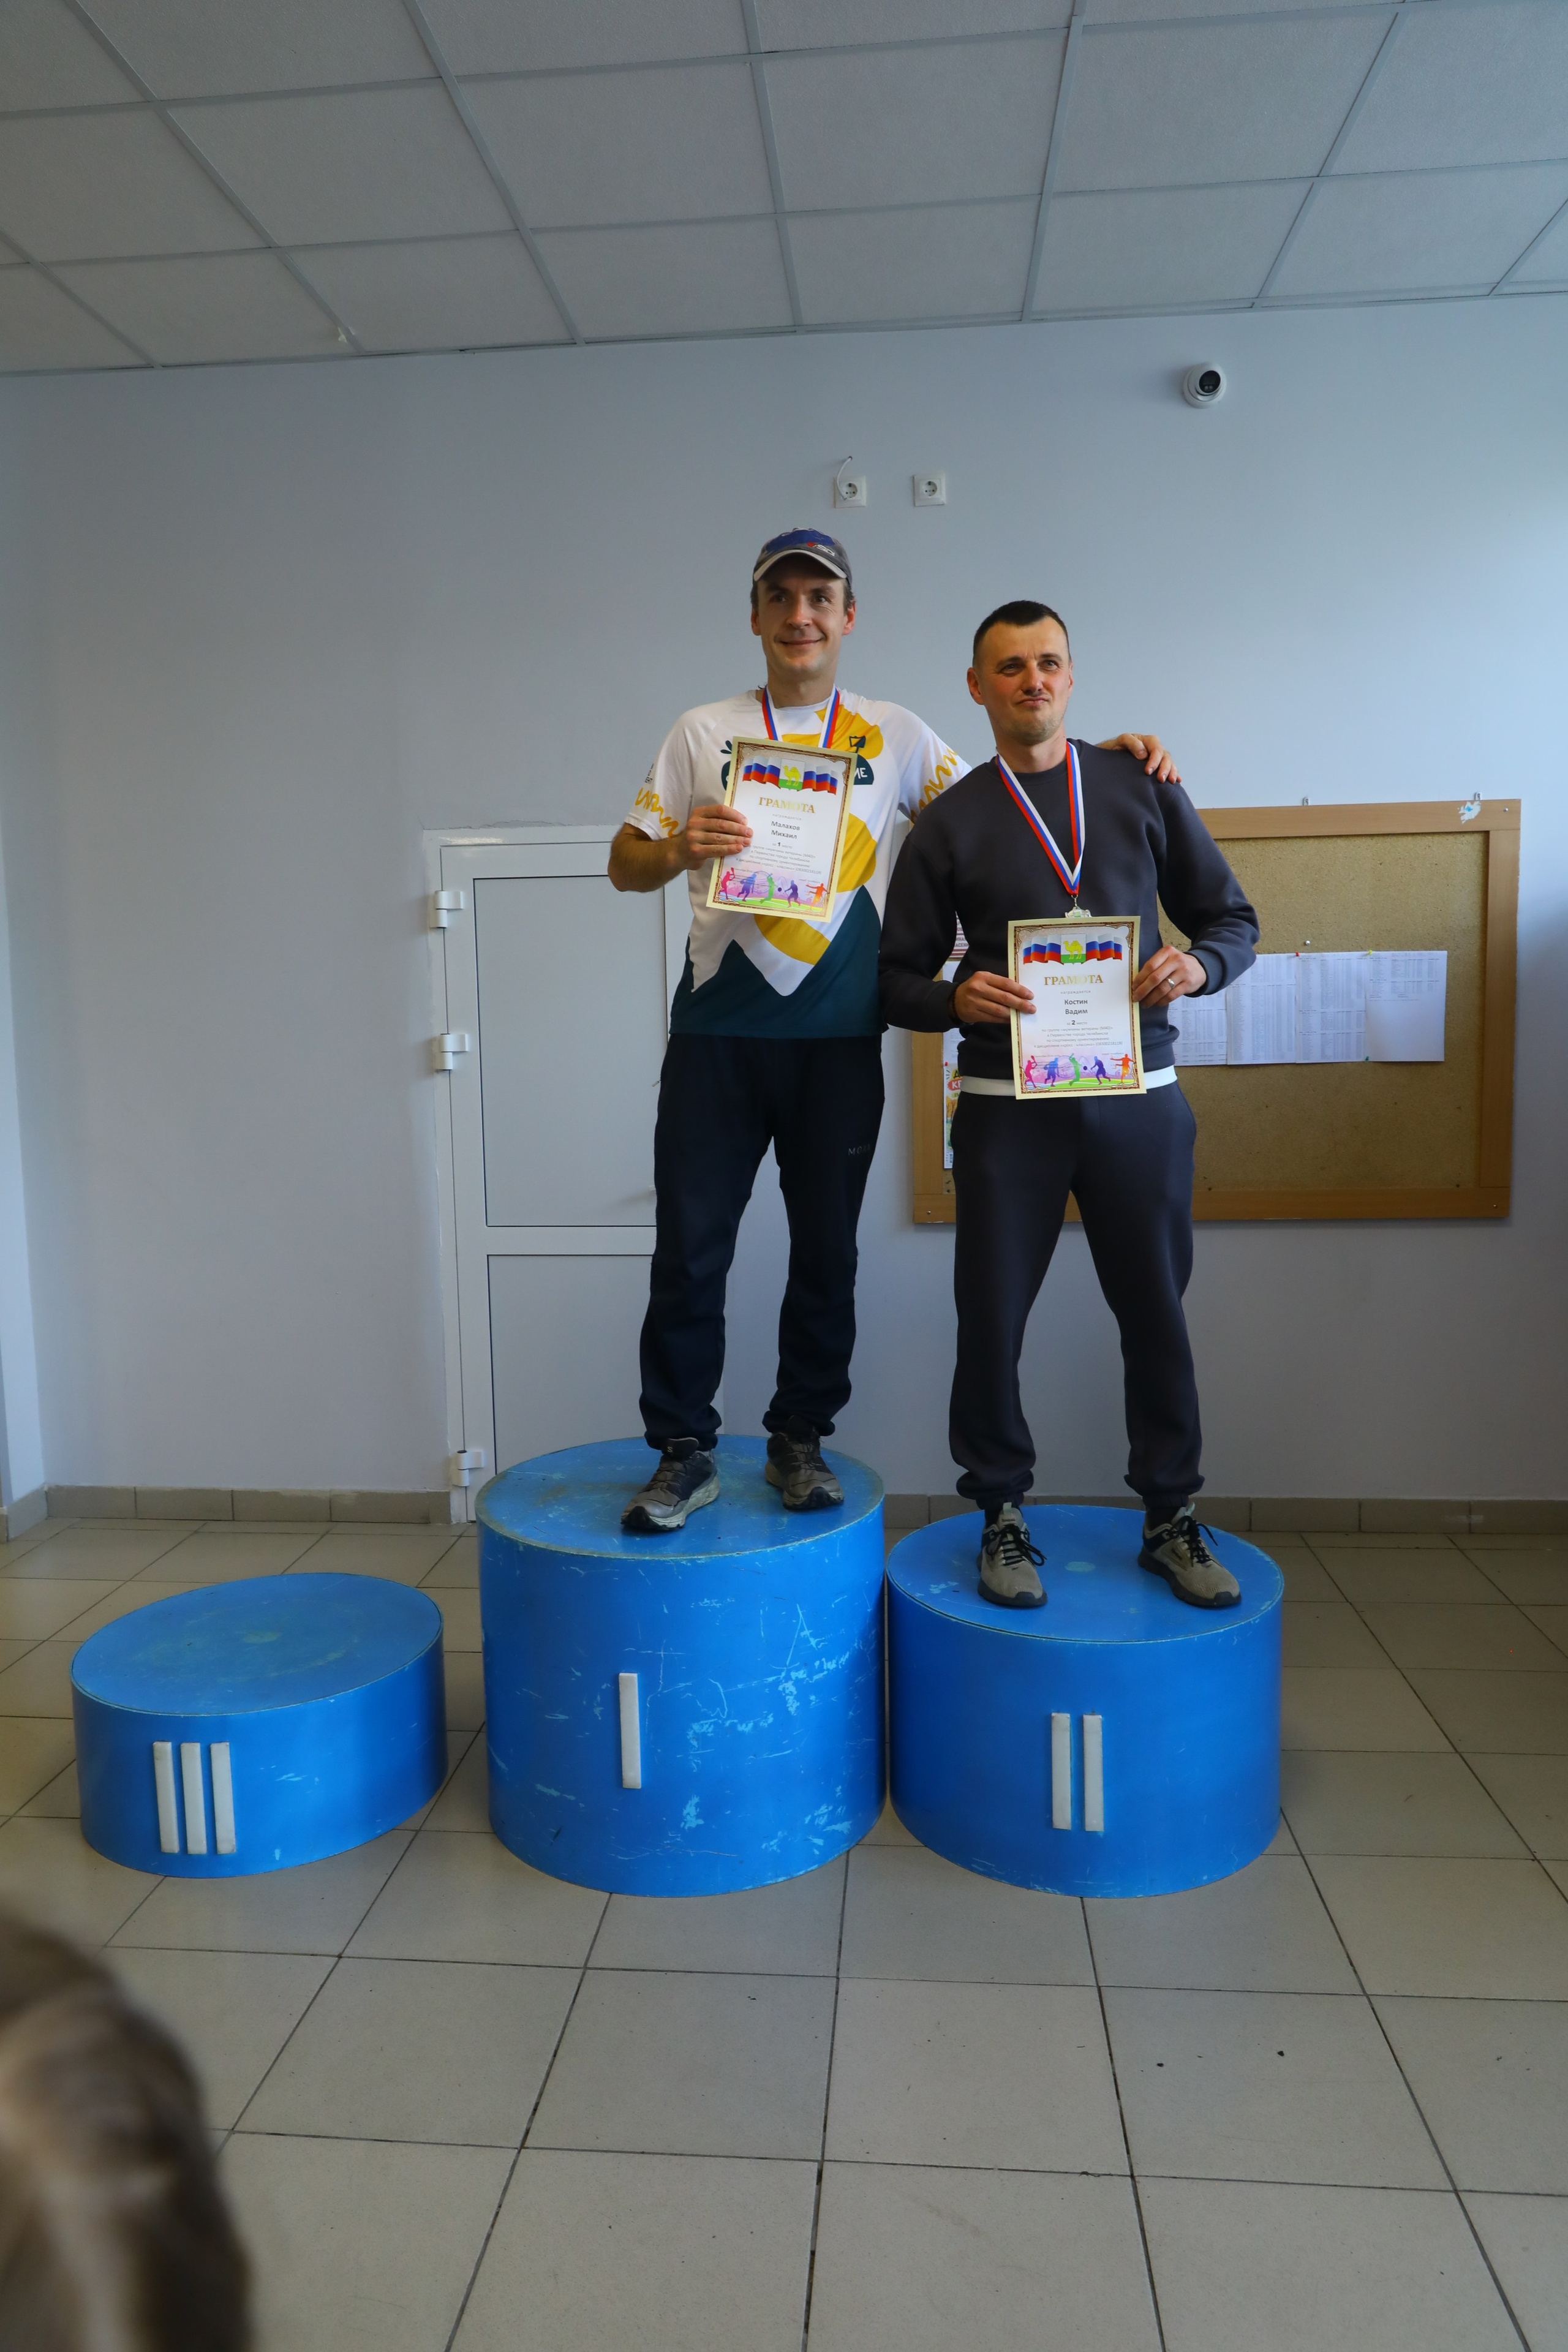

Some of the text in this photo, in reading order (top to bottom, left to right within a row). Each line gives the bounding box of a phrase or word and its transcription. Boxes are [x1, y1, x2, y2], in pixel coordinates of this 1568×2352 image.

[759, 797, 815, 813] ГРАМОТА
[771, 821, 801, 831] Малахов
[771, 830, 797, 839] Михаил
[1044, 974, 1103, 986] ГРАМОТА
